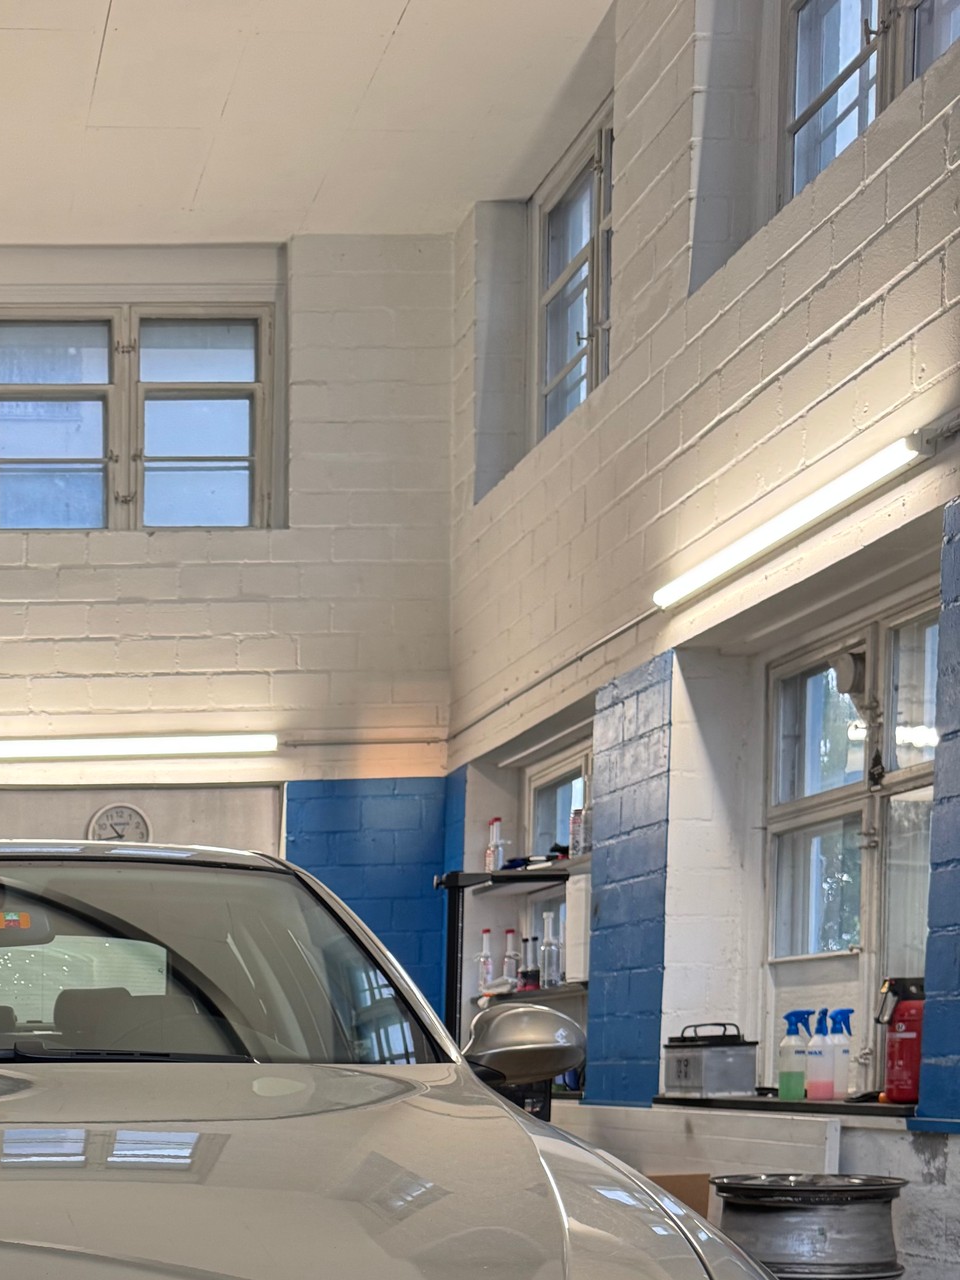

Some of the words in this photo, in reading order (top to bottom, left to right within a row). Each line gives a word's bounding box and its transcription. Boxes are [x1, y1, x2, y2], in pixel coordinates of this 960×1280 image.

[105, 813, 114, 822] 11
[115, 810, 125, 819] 12
[97, 822, 108, 831] 10
[134, 820, 141, 830] 2
[137, 831, 145, 840] 3
